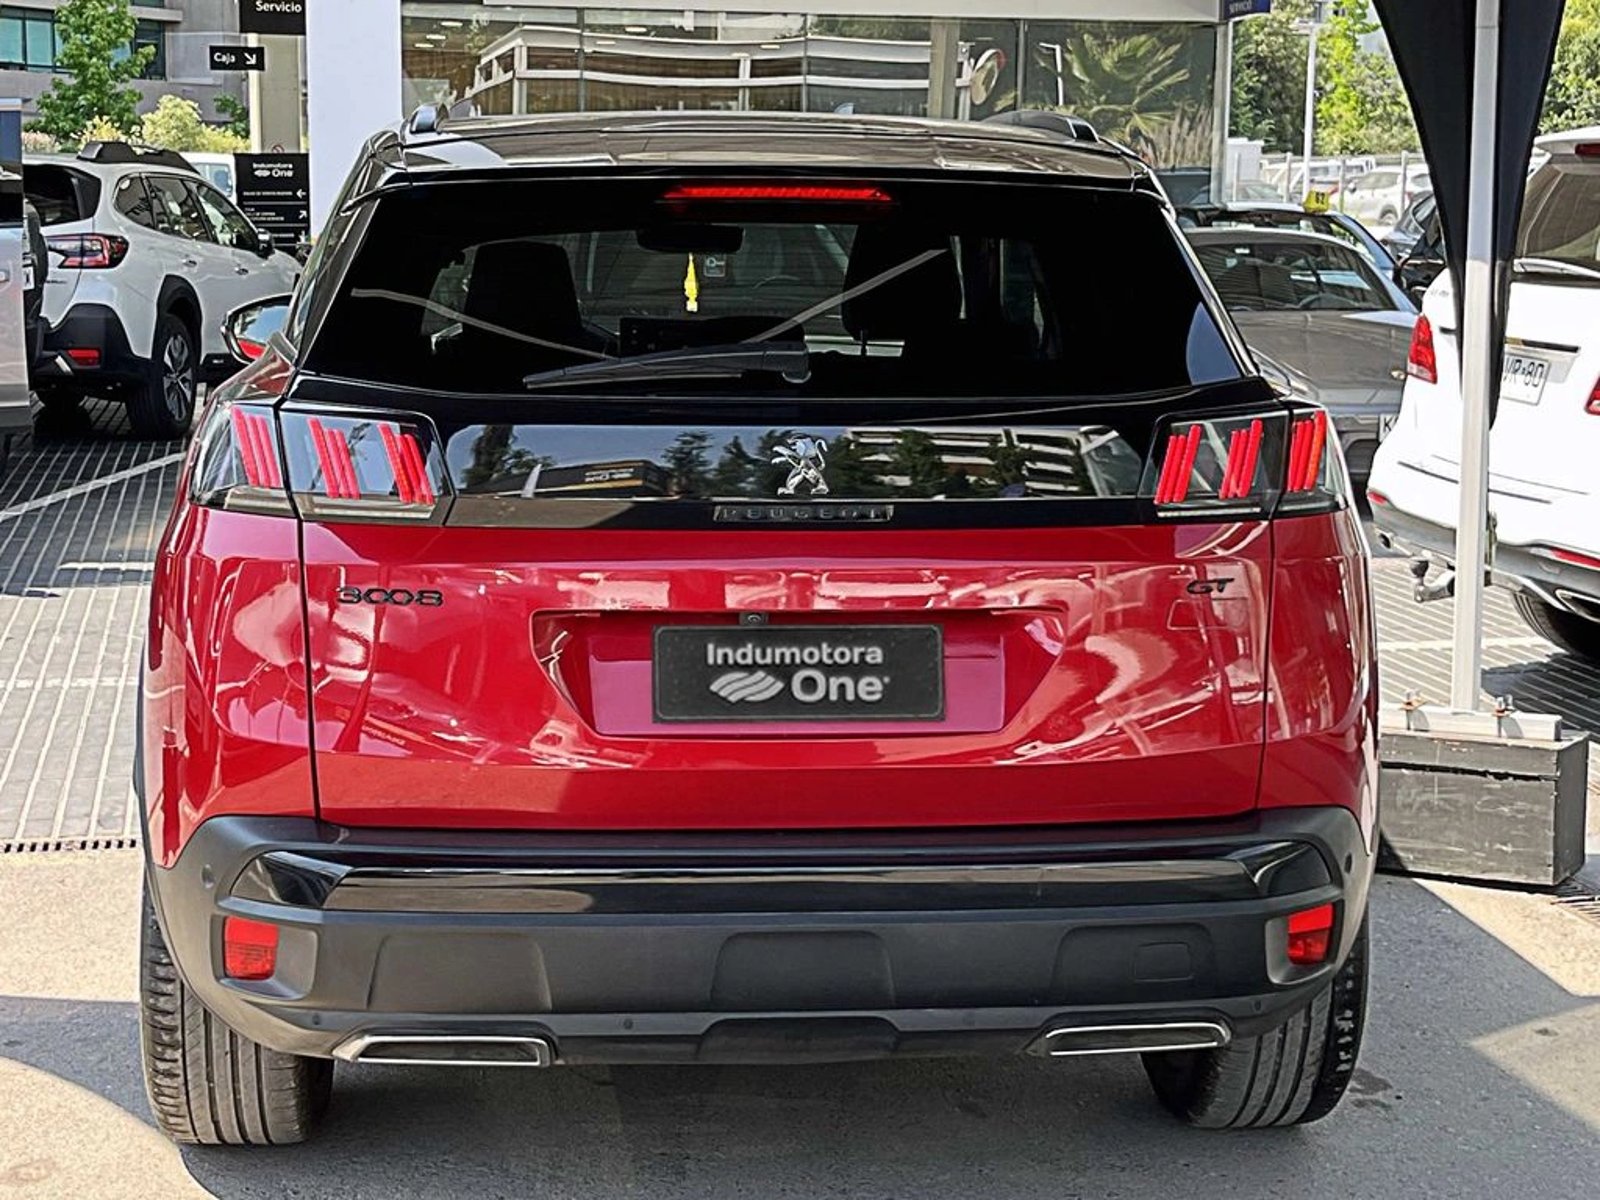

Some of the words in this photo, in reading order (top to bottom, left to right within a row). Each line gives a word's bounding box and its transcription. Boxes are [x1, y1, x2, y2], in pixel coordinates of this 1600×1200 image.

[255, 0, 303, 13] Servicio
[213, 52, 236, 65] Caja
[271, 168, 294, 178] One
[723, 505, 878, 520] PEUGEOT
[1187, 577, 1235, 595] GT
[337, 586, 443, 606] 3008
[706, 642, 883, 666] Indumotora
[791, 668, 885, 703] One
